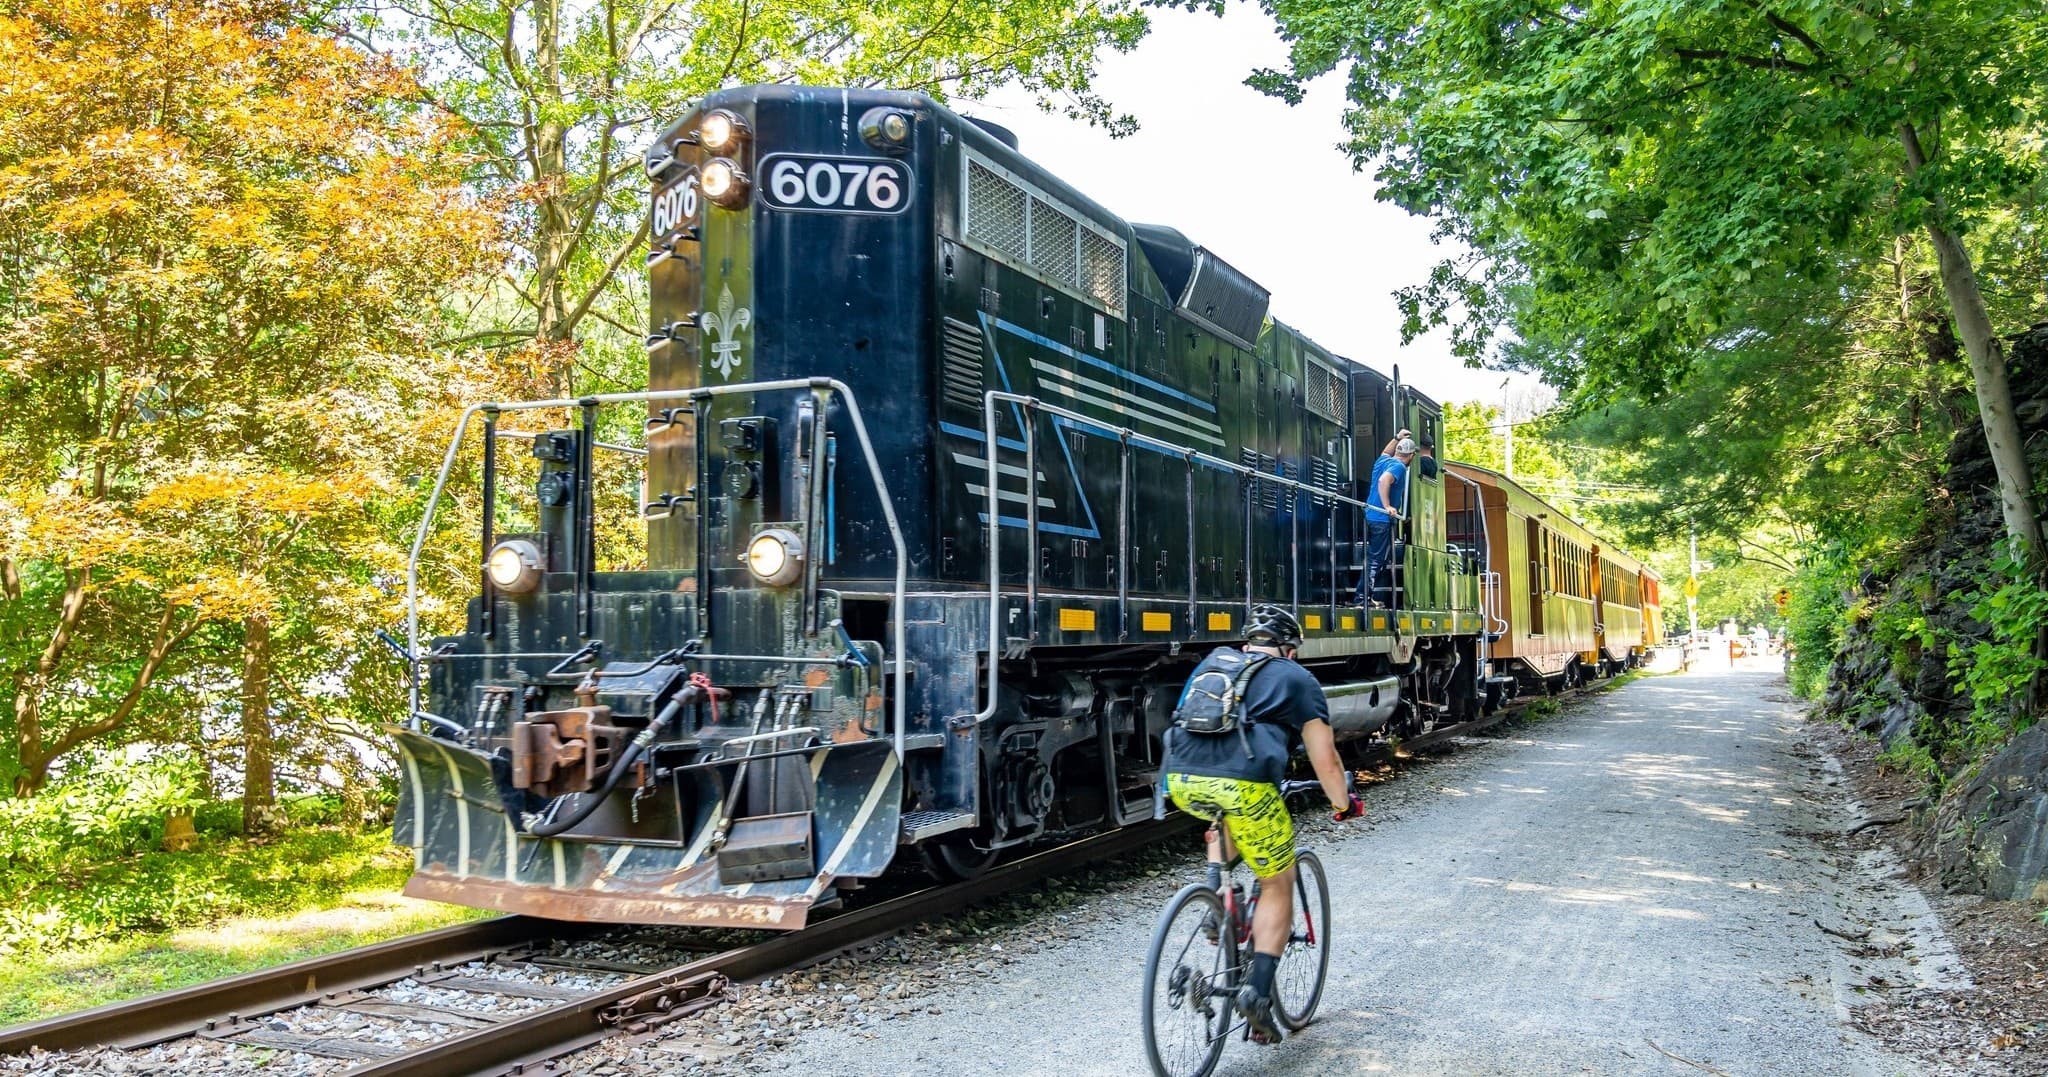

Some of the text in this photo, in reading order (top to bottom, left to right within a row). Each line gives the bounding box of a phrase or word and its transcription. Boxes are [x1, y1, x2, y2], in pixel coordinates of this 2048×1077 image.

[654, 175, 699, 237] 6076
[771, 160, 900, 209] 6076
[1009, 607, 1021, 624] F
